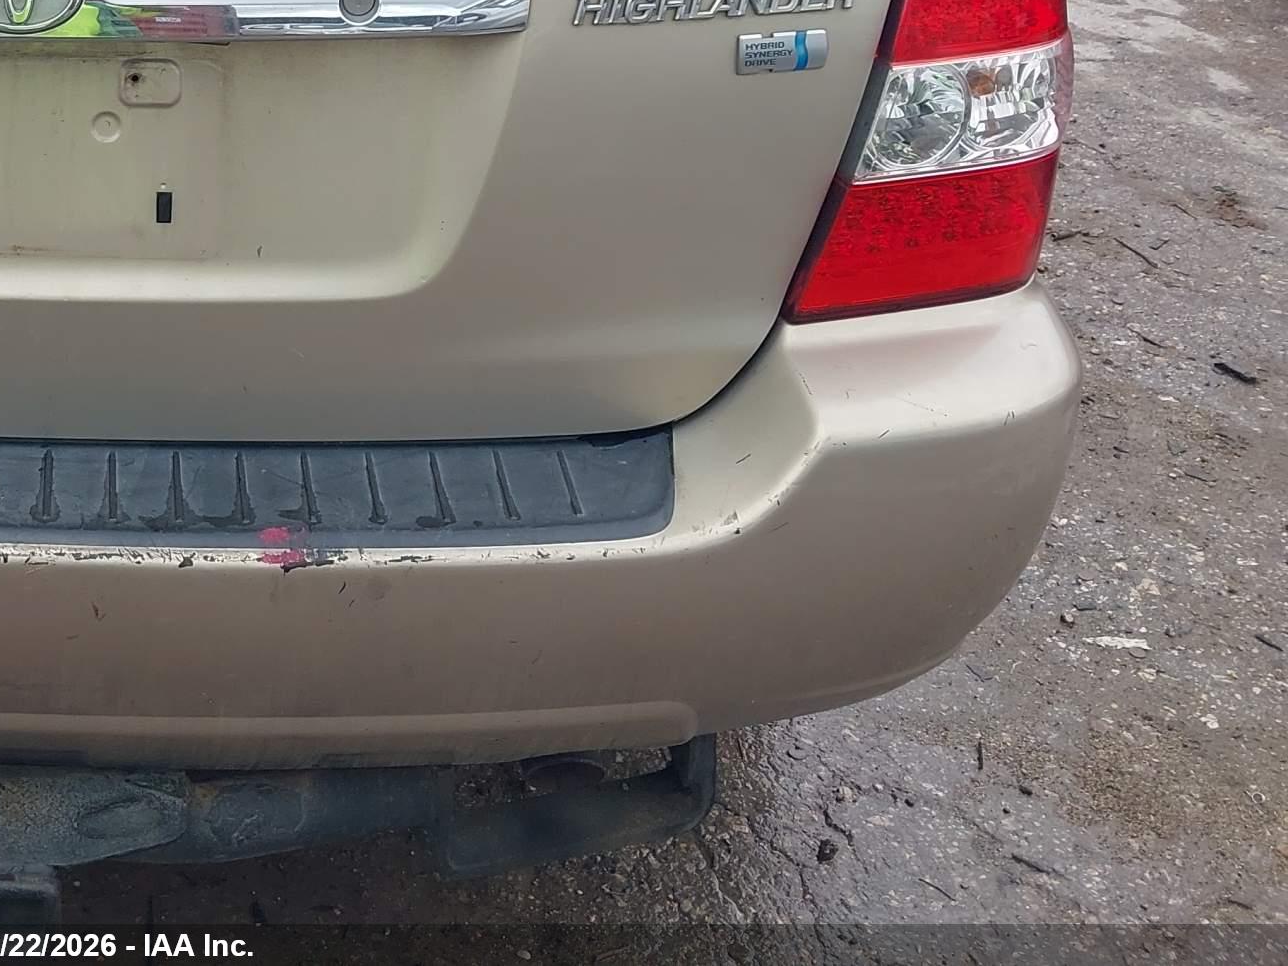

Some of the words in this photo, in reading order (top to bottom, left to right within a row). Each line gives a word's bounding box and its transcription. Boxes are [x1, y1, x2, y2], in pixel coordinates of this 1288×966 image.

[744, 41, 785, 51] HYBRID
[744, 49, 793, 59] SYNERGY
[744, 58, 777, 67] DRIVE
